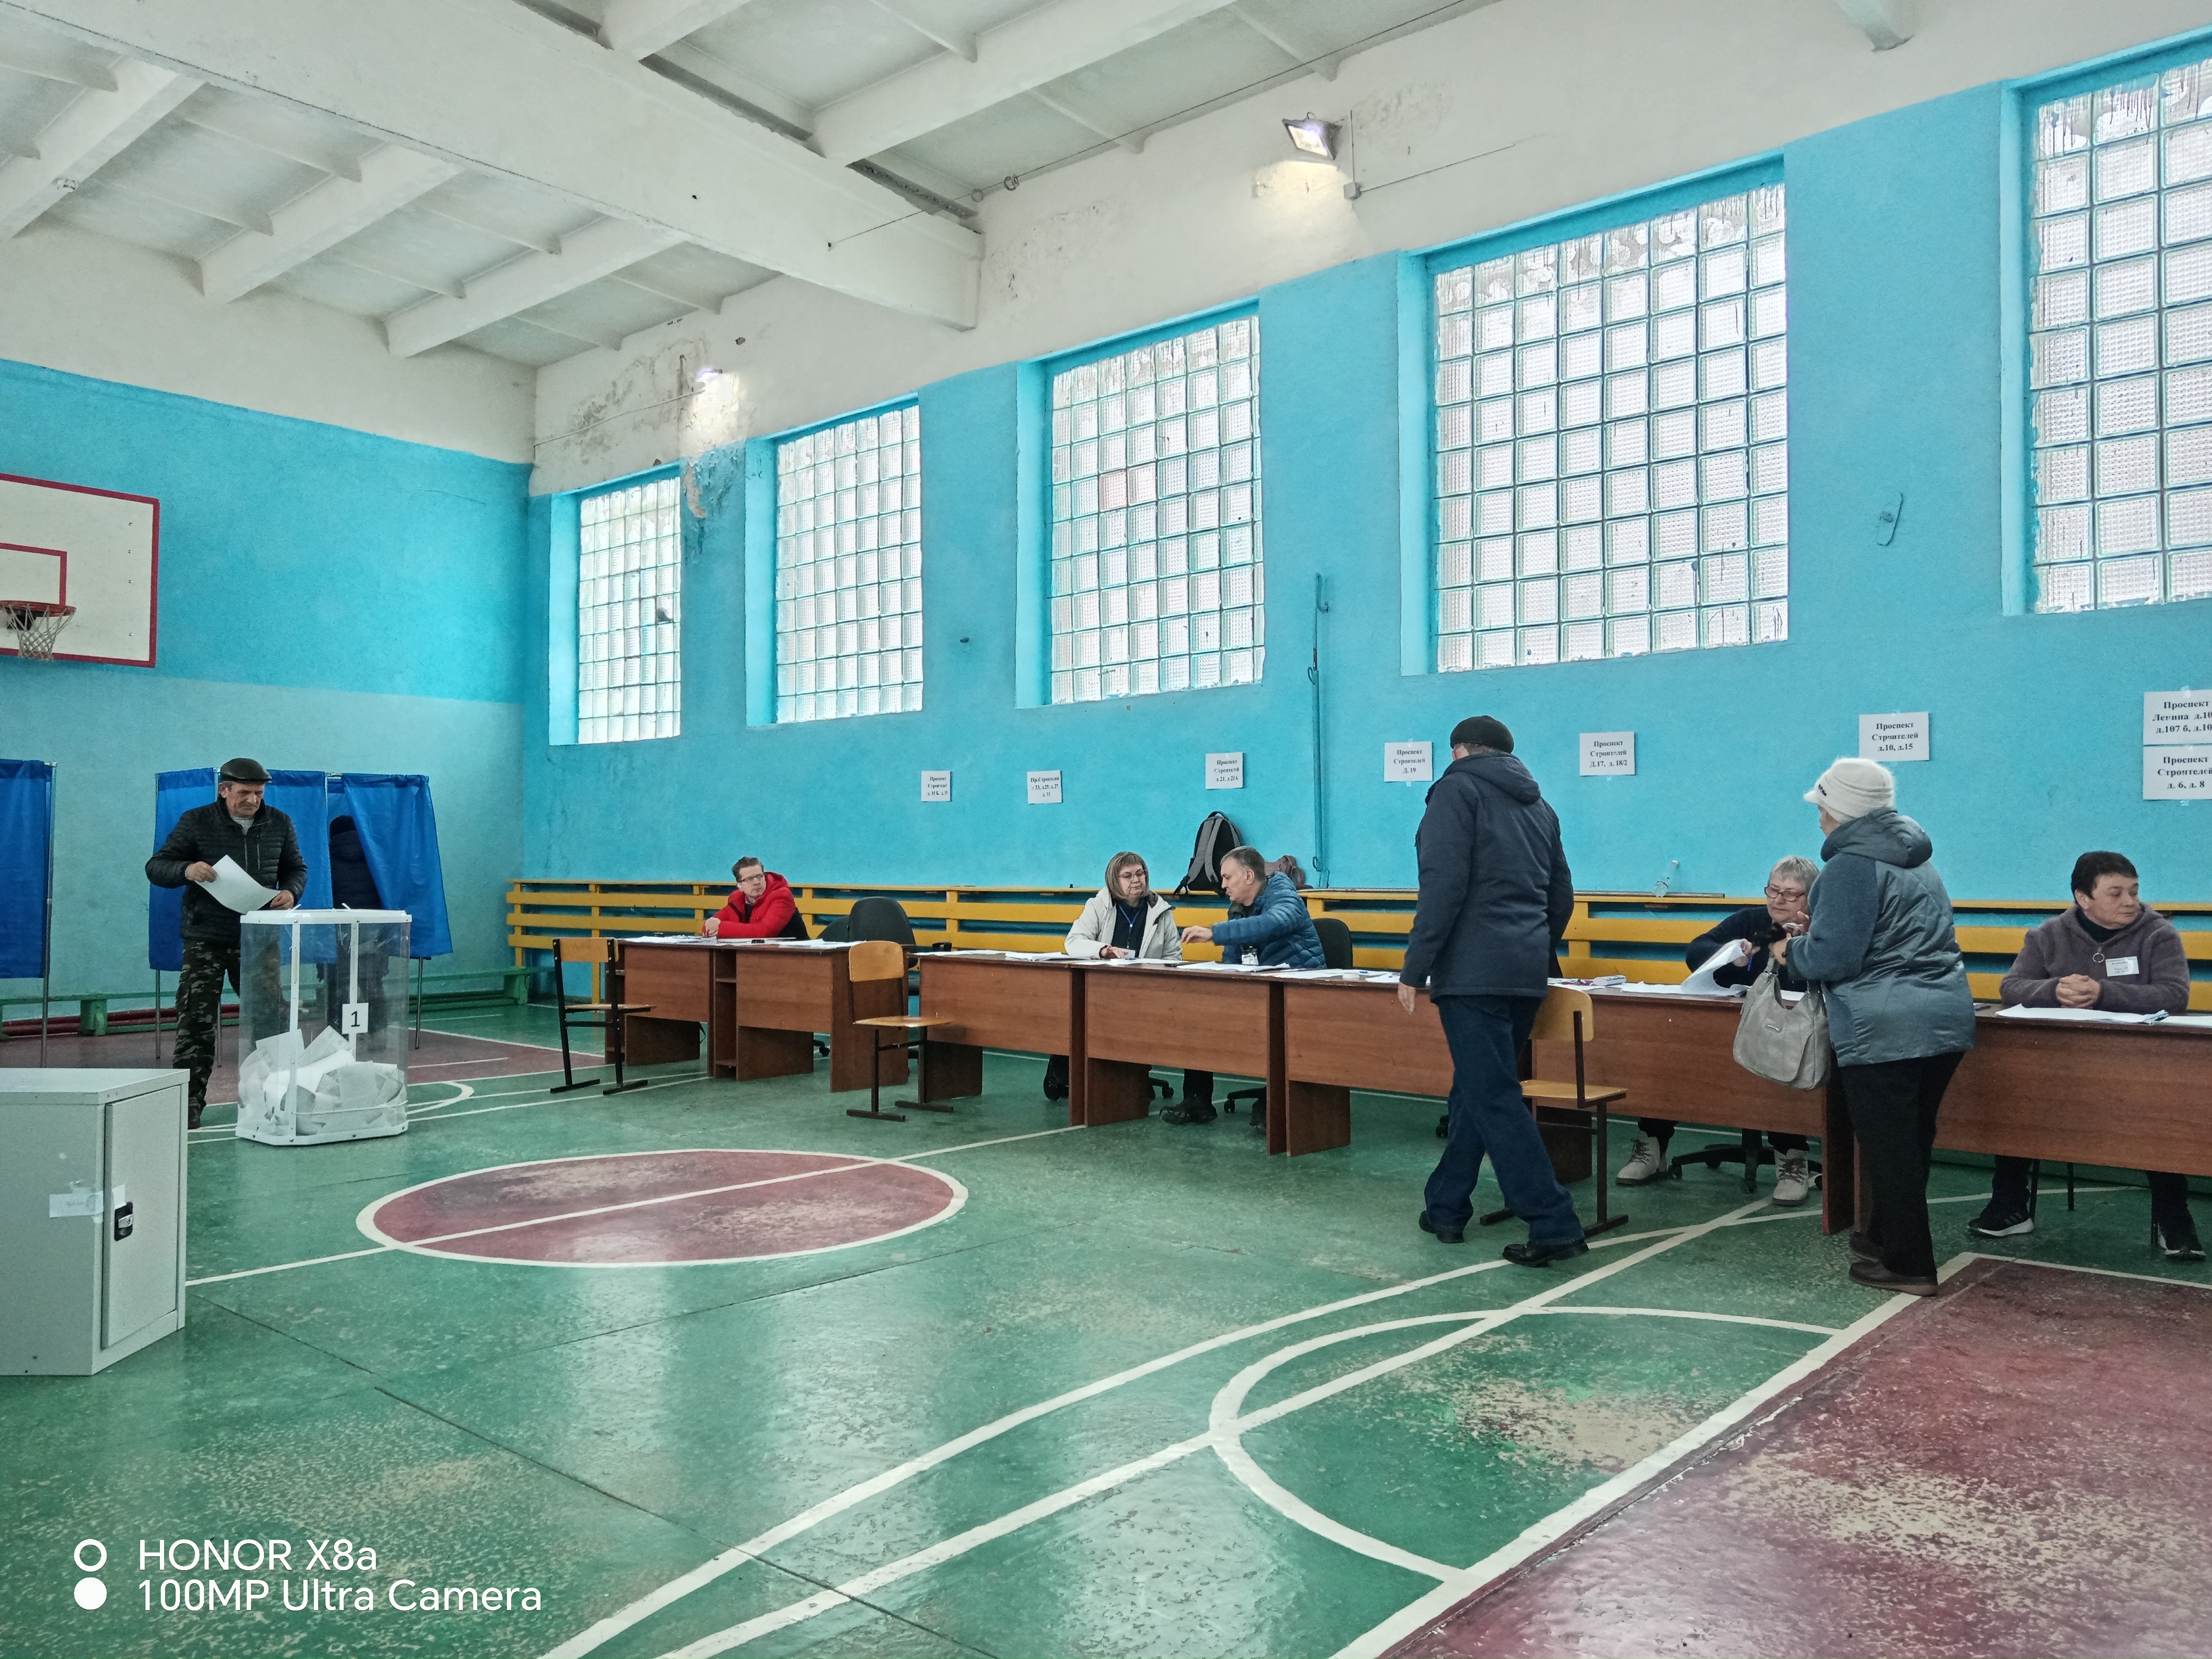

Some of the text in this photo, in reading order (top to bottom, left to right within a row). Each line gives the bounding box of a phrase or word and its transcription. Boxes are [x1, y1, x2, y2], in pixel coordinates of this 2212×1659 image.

[2163, 701, 2209, 710] Проспект
[1876, 723, 1914, 731] Проспект
[2156, 726, 2180, 734] д.107
[1872, 732, 1918, 742] Строителей
[1590, 750, 1627, 758] Строителей
[2163, 757, 2208, 765] Проспект
[351, 1011, 360, 1027] 1
